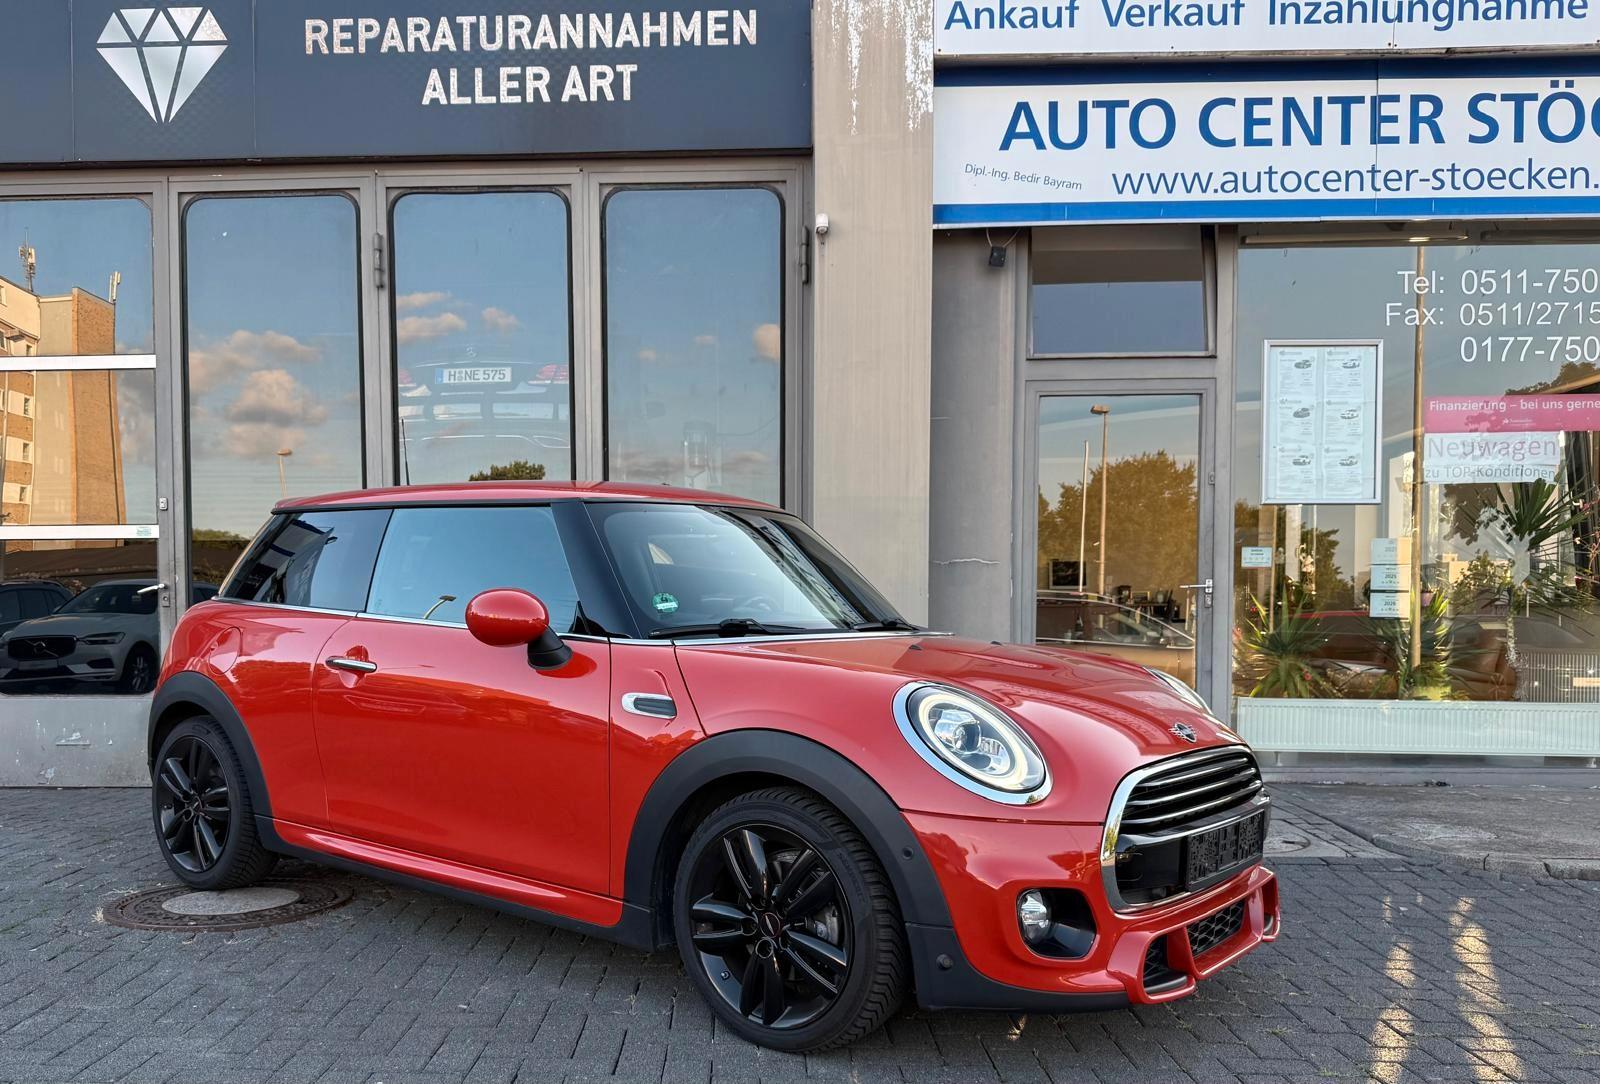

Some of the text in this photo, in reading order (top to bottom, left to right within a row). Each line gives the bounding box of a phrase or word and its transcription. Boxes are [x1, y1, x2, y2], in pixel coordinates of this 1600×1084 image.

[944, 0, 1079, 30] Ankauf
[1104, 0, 1245, 28] Verkauf
[304, 9, 757, 54] REPARATURANNAHMEN
[421, 64, 638, 105] ALLER ART
[999, 97, 1176, 151] AUTO
[1198, 93, 1446, 148] CENTER
[964, 163, 1082, 191] Dipl.-Ing. Bedir Bayram
[1397, 268, 1599, 295] Tel: 0511-750
[1385, 301, 1600, 327] Fax: 0511/2715
[1460, 335, 1600, 363] 0177-750
[1429, 400, 1507, 411] Finanzierung
[1520, 400, 1538, 410] bei
[1428, 436, 1556, 462] Neuwagen
[1425, 465, 1555, 479] zu TOP-Konditionen
